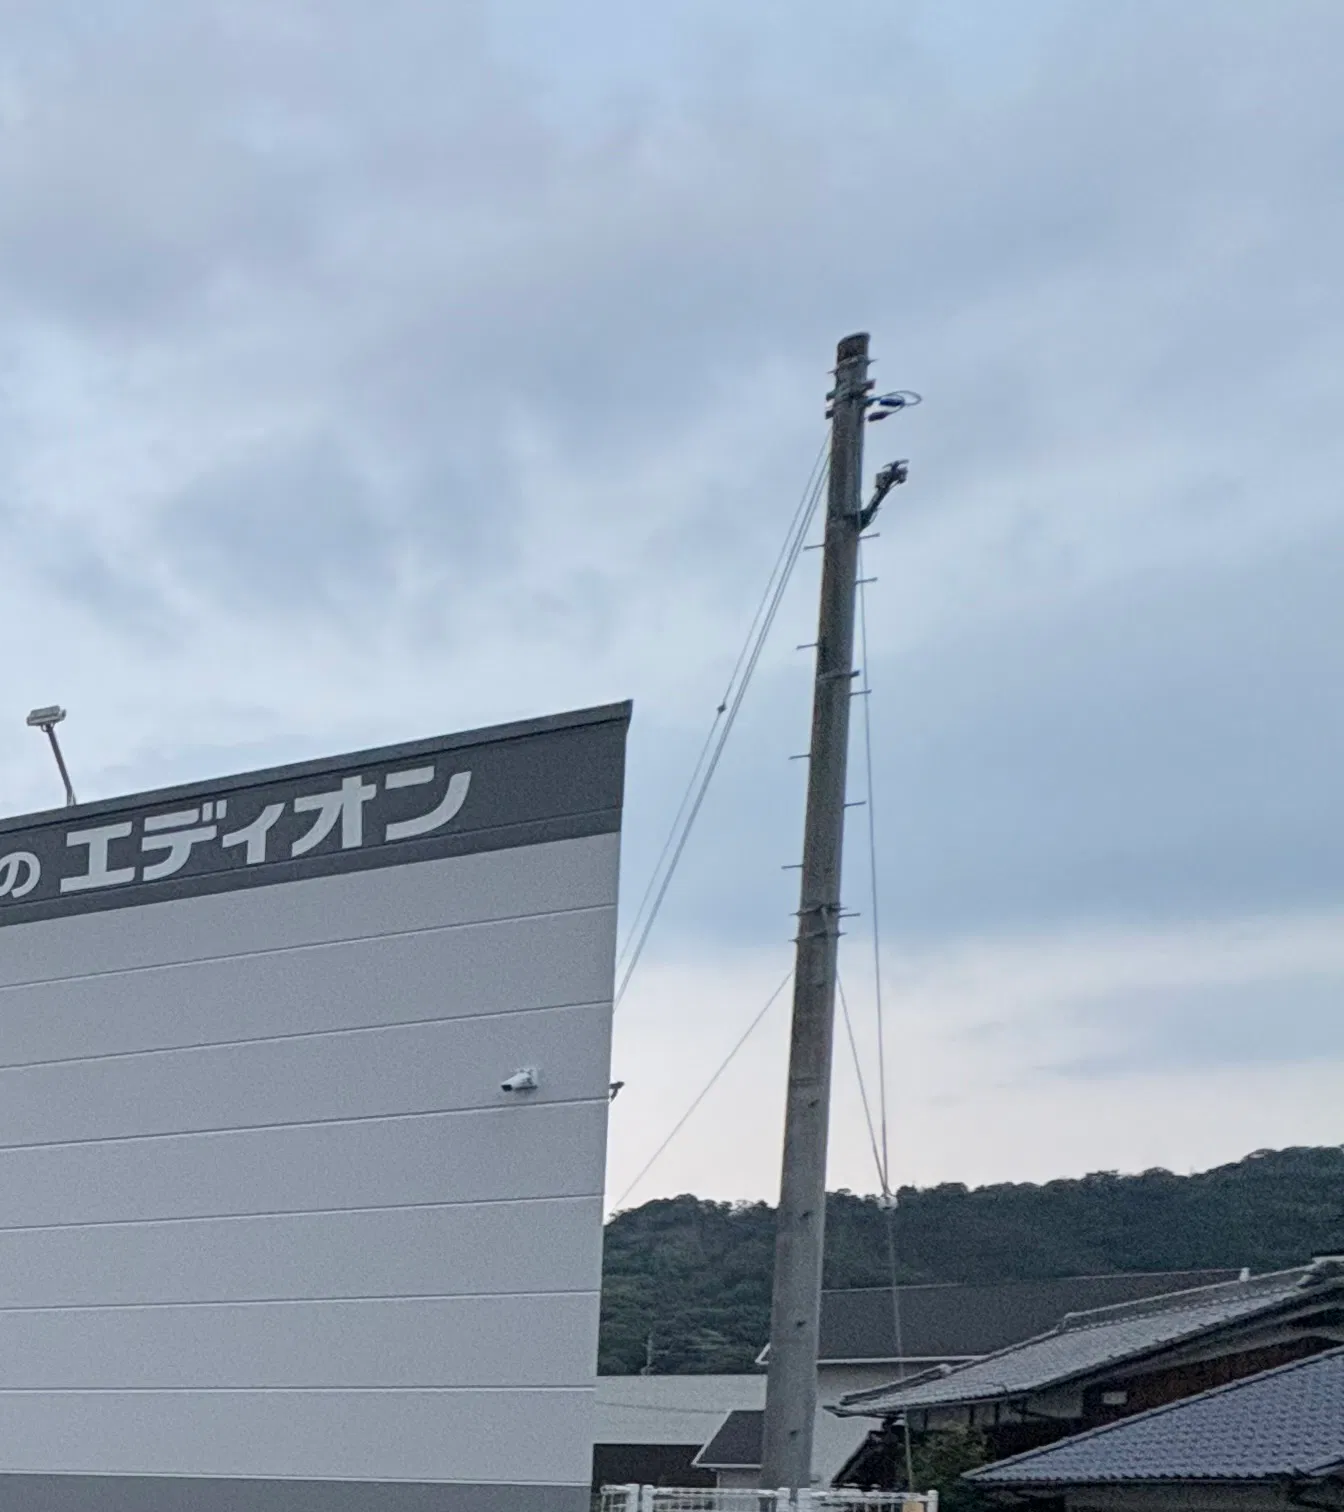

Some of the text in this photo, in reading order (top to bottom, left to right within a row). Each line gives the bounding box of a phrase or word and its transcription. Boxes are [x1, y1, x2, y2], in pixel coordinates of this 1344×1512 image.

[60, 766, 471, 893] エディオン
